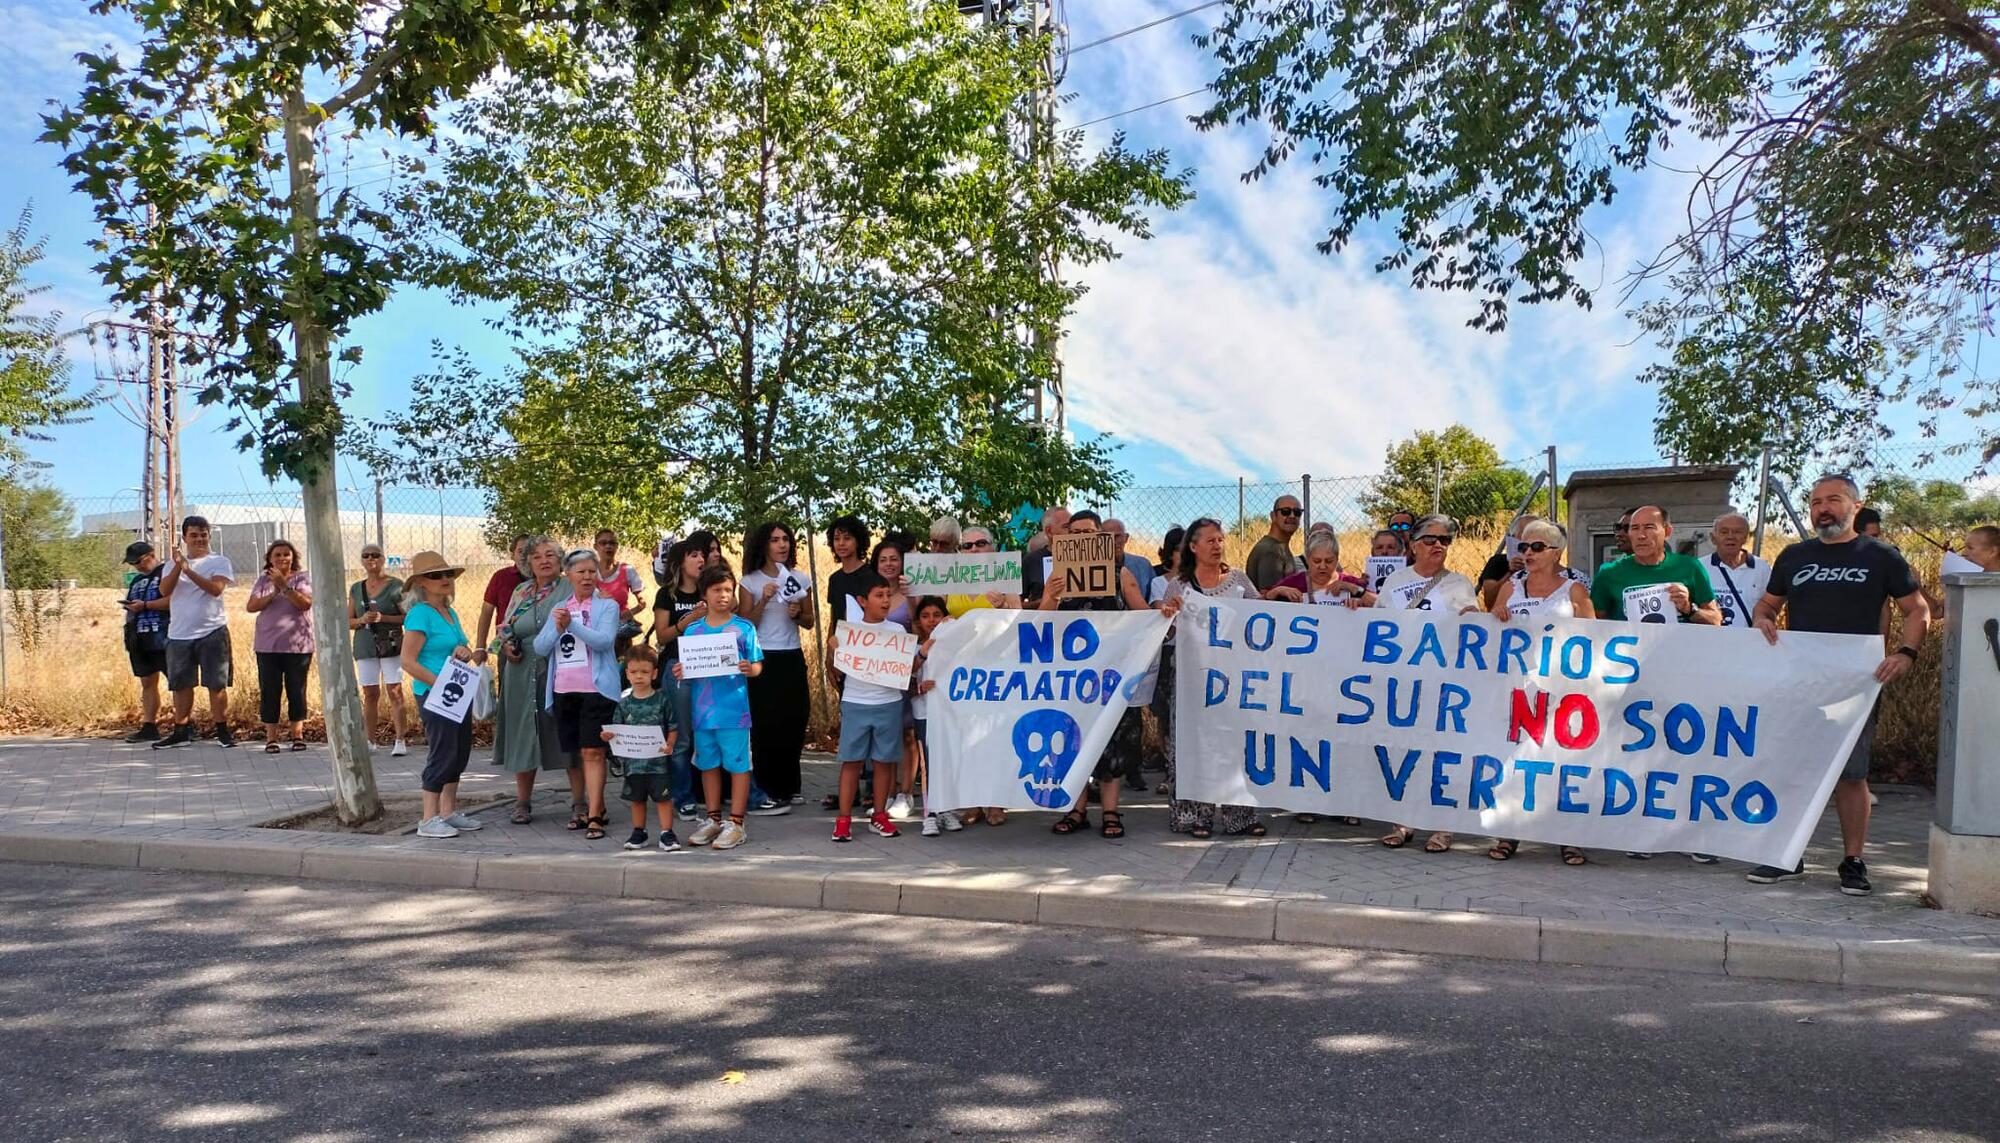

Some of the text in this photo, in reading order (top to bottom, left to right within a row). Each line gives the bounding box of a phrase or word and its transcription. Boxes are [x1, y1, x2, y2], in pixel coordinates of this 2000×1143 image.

[1066, 565, 1107, 592] NO
[1376, 564, 1396, 577] NO
[1393, 580, 1428, 593] CREMATORI
[1639, 597, 1662, 614] NO
[1017, 618, 1100, 664] NO
[1208, 606, 1320, 656] LOS
[450, 668, 469, 686] NO
[1204, 666, 1759, 758] DEL SUR NO SON
[1244, 729, 1779, 825] UN VERTEDERO
